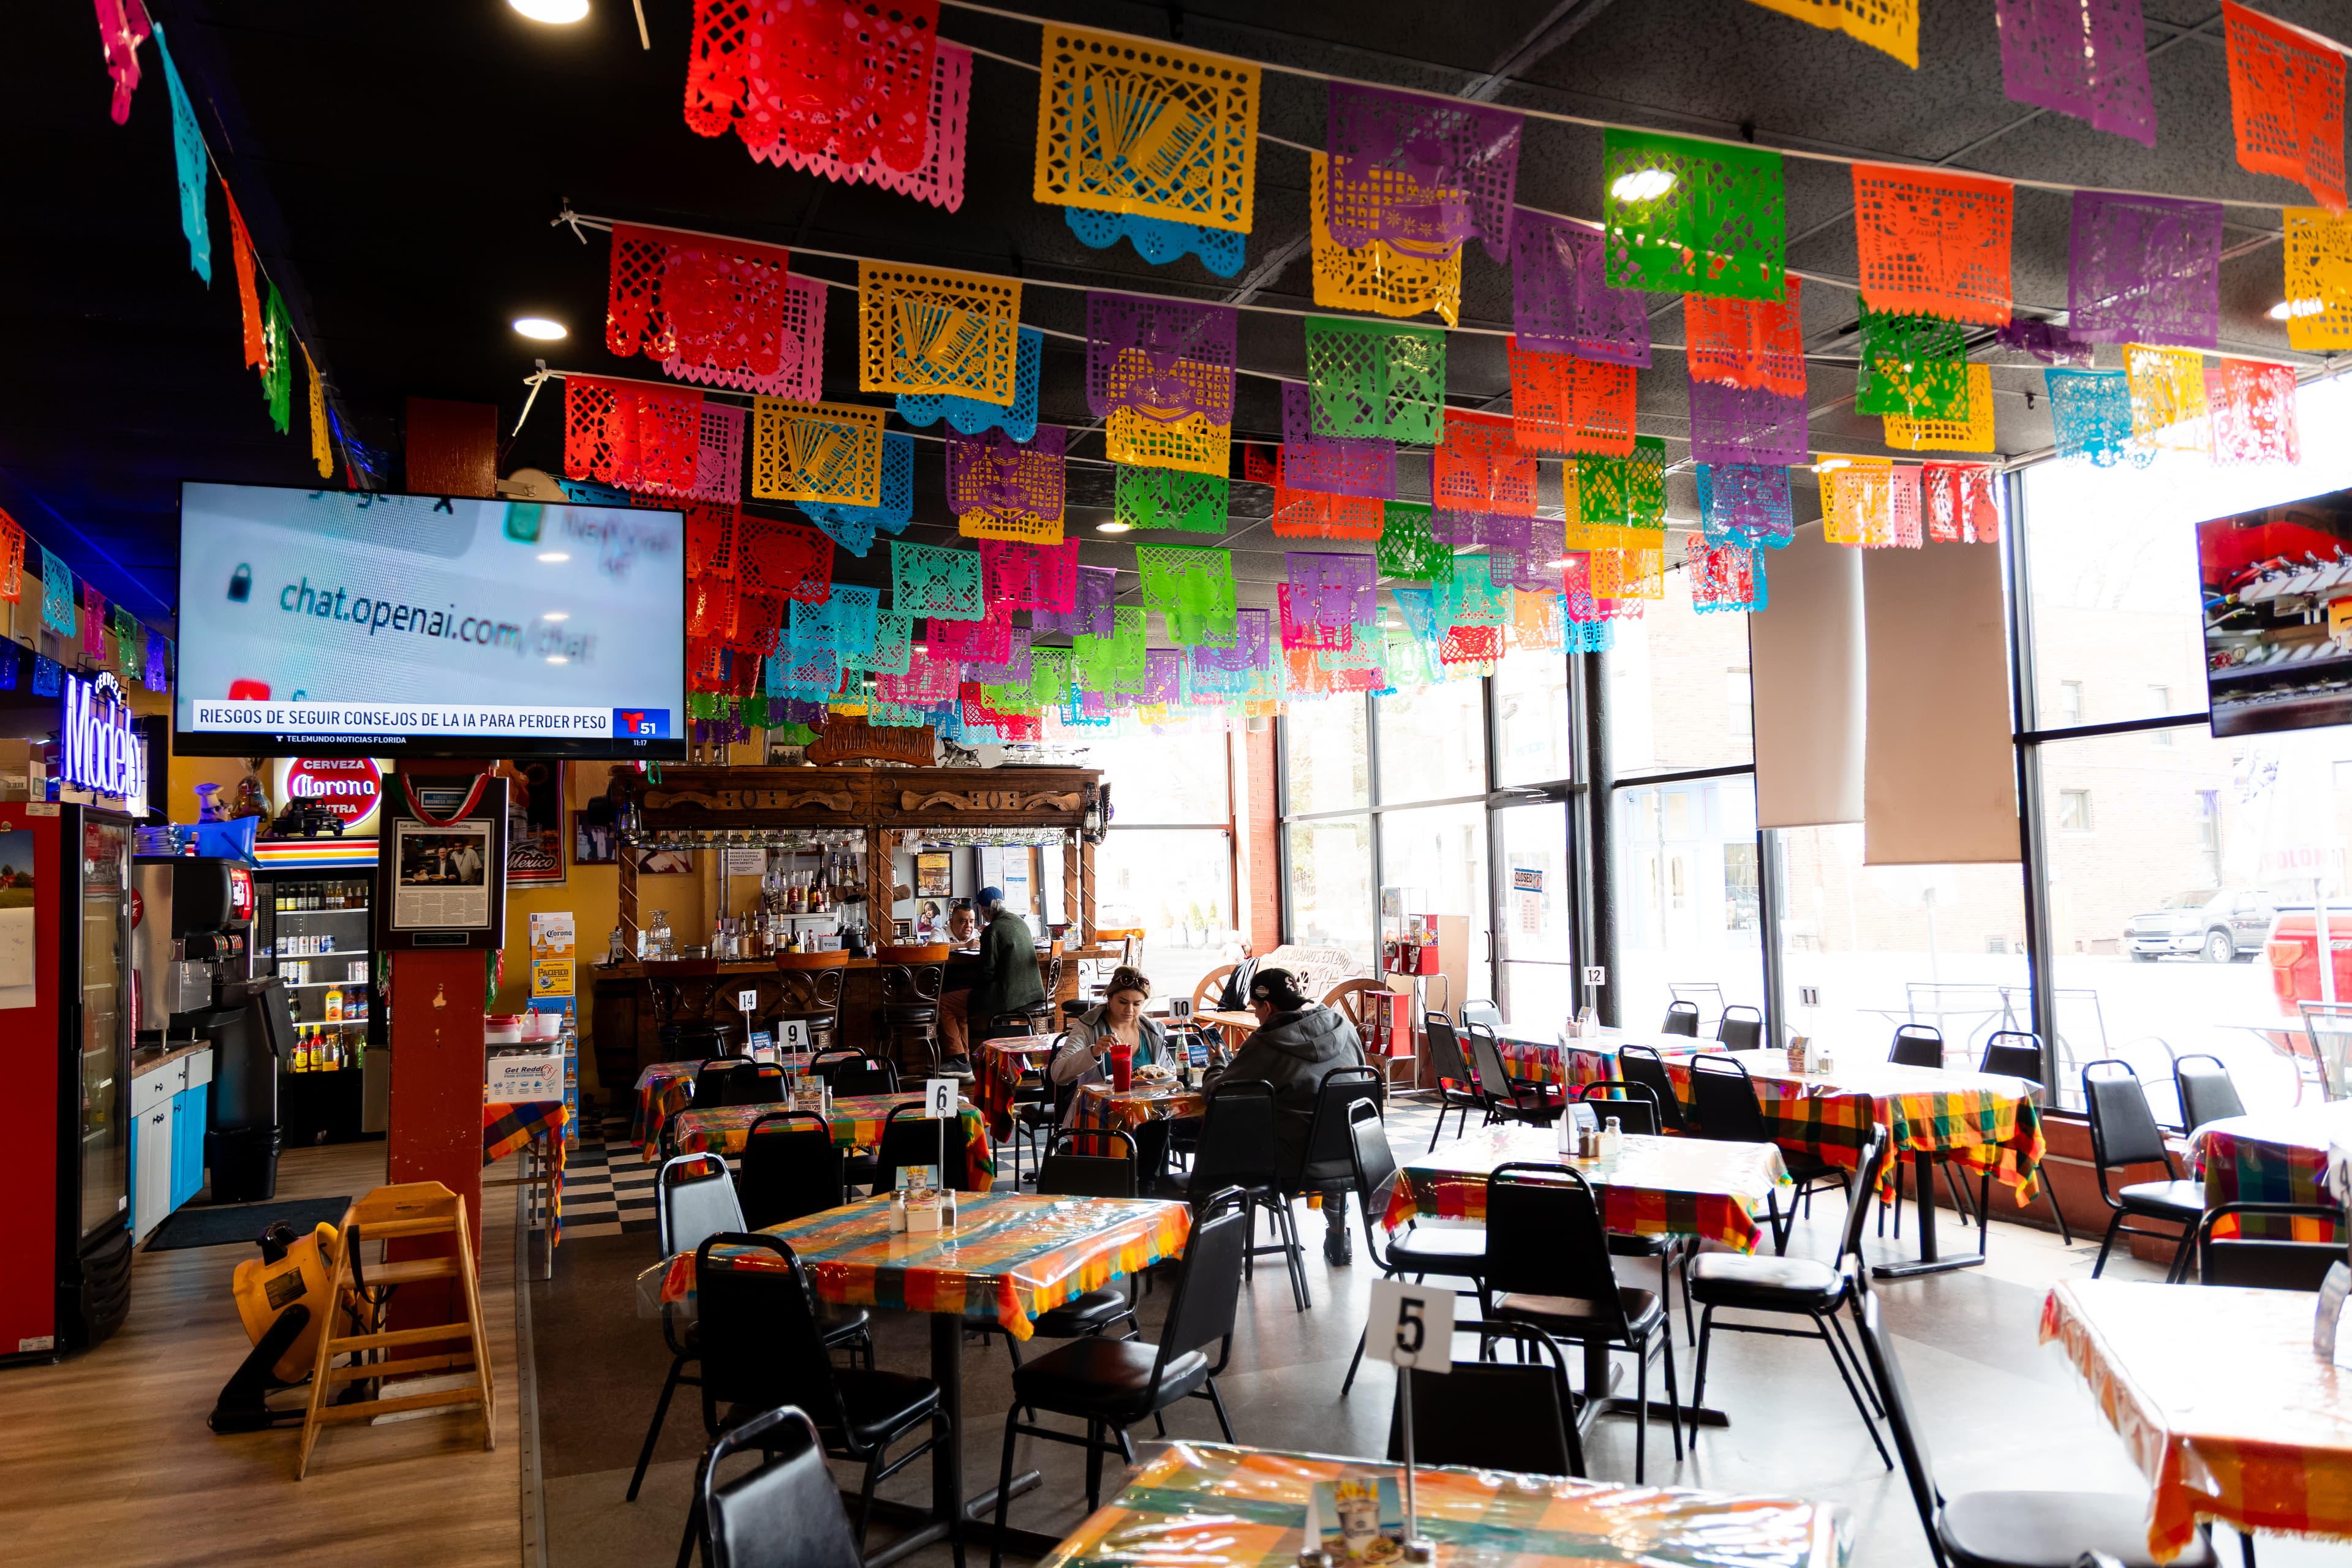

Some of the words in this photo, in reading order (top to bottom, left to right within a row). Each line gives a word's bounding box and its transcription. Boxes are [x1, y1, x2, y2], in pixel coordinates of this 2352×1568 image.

[95, 671, 121, 704] CERVEZA
[200, 709, 262, 723] RIESGOS
[267, 710, 284, 724] DE
[289, 710, 339, 725] SEGUIR
[344, 711, 417, 726] CONSEJOS
[421, 713, 439, 726] DE
[443, 713, 458, 726] LA
[464, 714, 476, 727] IA
[480, 714, 515, 728] PARA
[519, 714, 569, 728] PERDER
[573, 715, 606, 729] PESO
[65, 673, 141, 797] Modelo
[640, 722, 656, 734] 51
[823, 724, 872, 752] CANTINA
[876, 726, 891, 750] LOS
[892, 727, 933, 758] ALAMOS
[303, 760, 365, 769] CERVEZA
[293, 774, 375, 796] Corona
[508, 853, 553, 868] México
[1515, 872, 1532, 883] CLOSED
[538, 968, 568, 977] PACIFICO
[1588, 970, 1600, 982] 12
[742, 993, 753, 1008] 14
[1803, 989, 1817, 1004] 11
[1174, 1001, 1189, 1016] 10
[788, 1025, 797, 1042] 9
[937, 1085, 947, 1110] 6
[1395, 1296, 1425, 1353] 5
